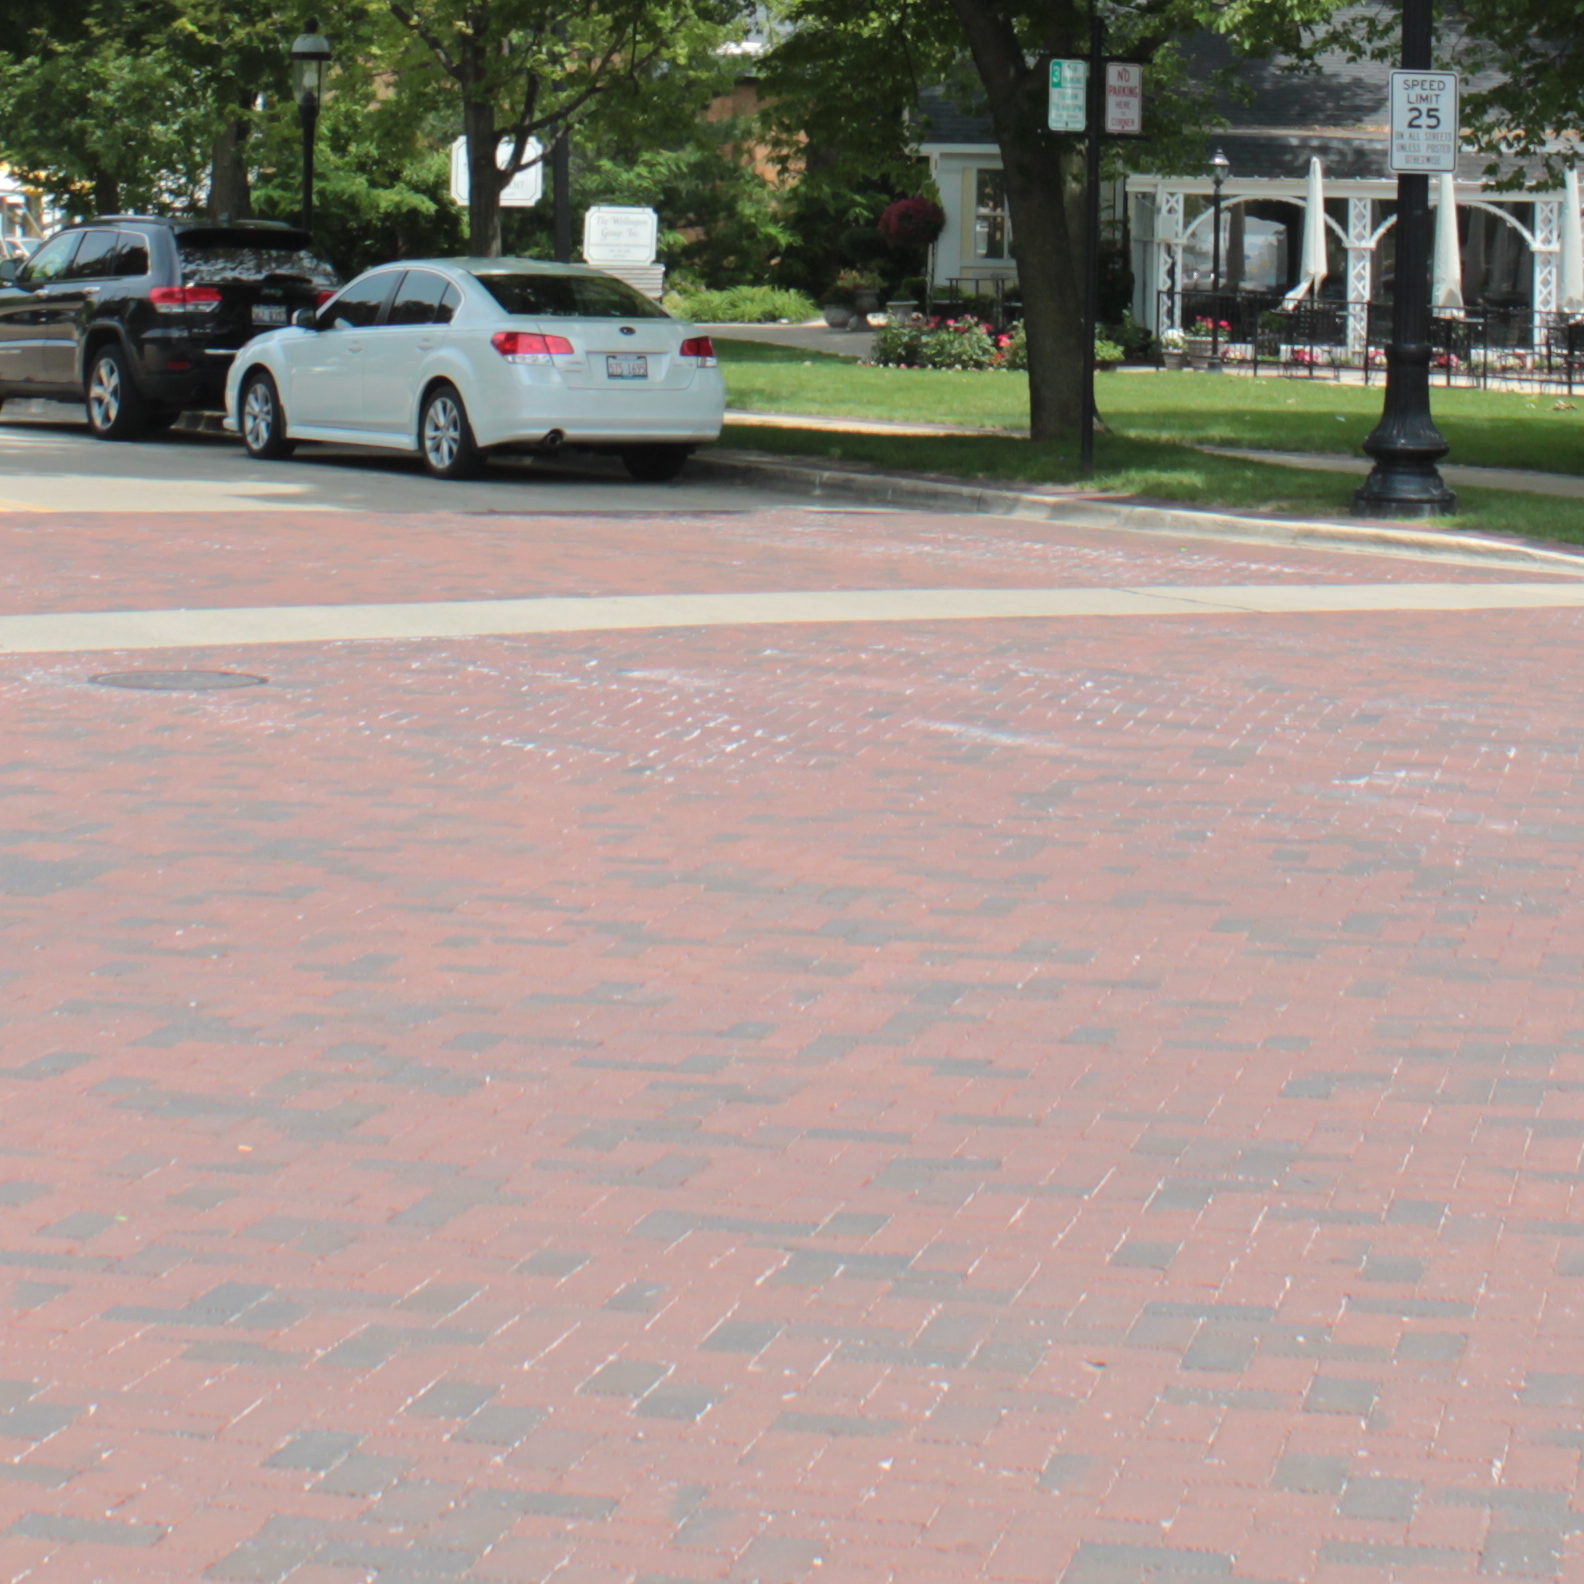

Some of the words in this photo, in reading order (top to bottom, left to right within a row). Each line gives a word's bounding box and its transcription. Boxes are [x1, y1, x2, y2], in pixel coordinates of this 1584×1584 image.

[1052, 65, 1060, 83] 3
[1118, 69, 1130, 82] NO
[1403, 79, 1446, 91] SPEED
[1108, 85, 1138, 98] PARKING
[1407, 93, 1440, 104] LIMIT
[1116, 101, 1131, 110] HERE
[1111, 118, 1135, 127] CORNER
[1407, 107, 1441, 129] 25
[1395, 131, 1404, 140] ON
[1408, 131, 1420, 141] ALL
[1425, 132, 1452, 142] STREETS
[1396, 143, 1420, 153] UNLESS
[1426, 143, 1451, 153] POSTED
[1405, 155, 1441, 165] OTHERWISE
